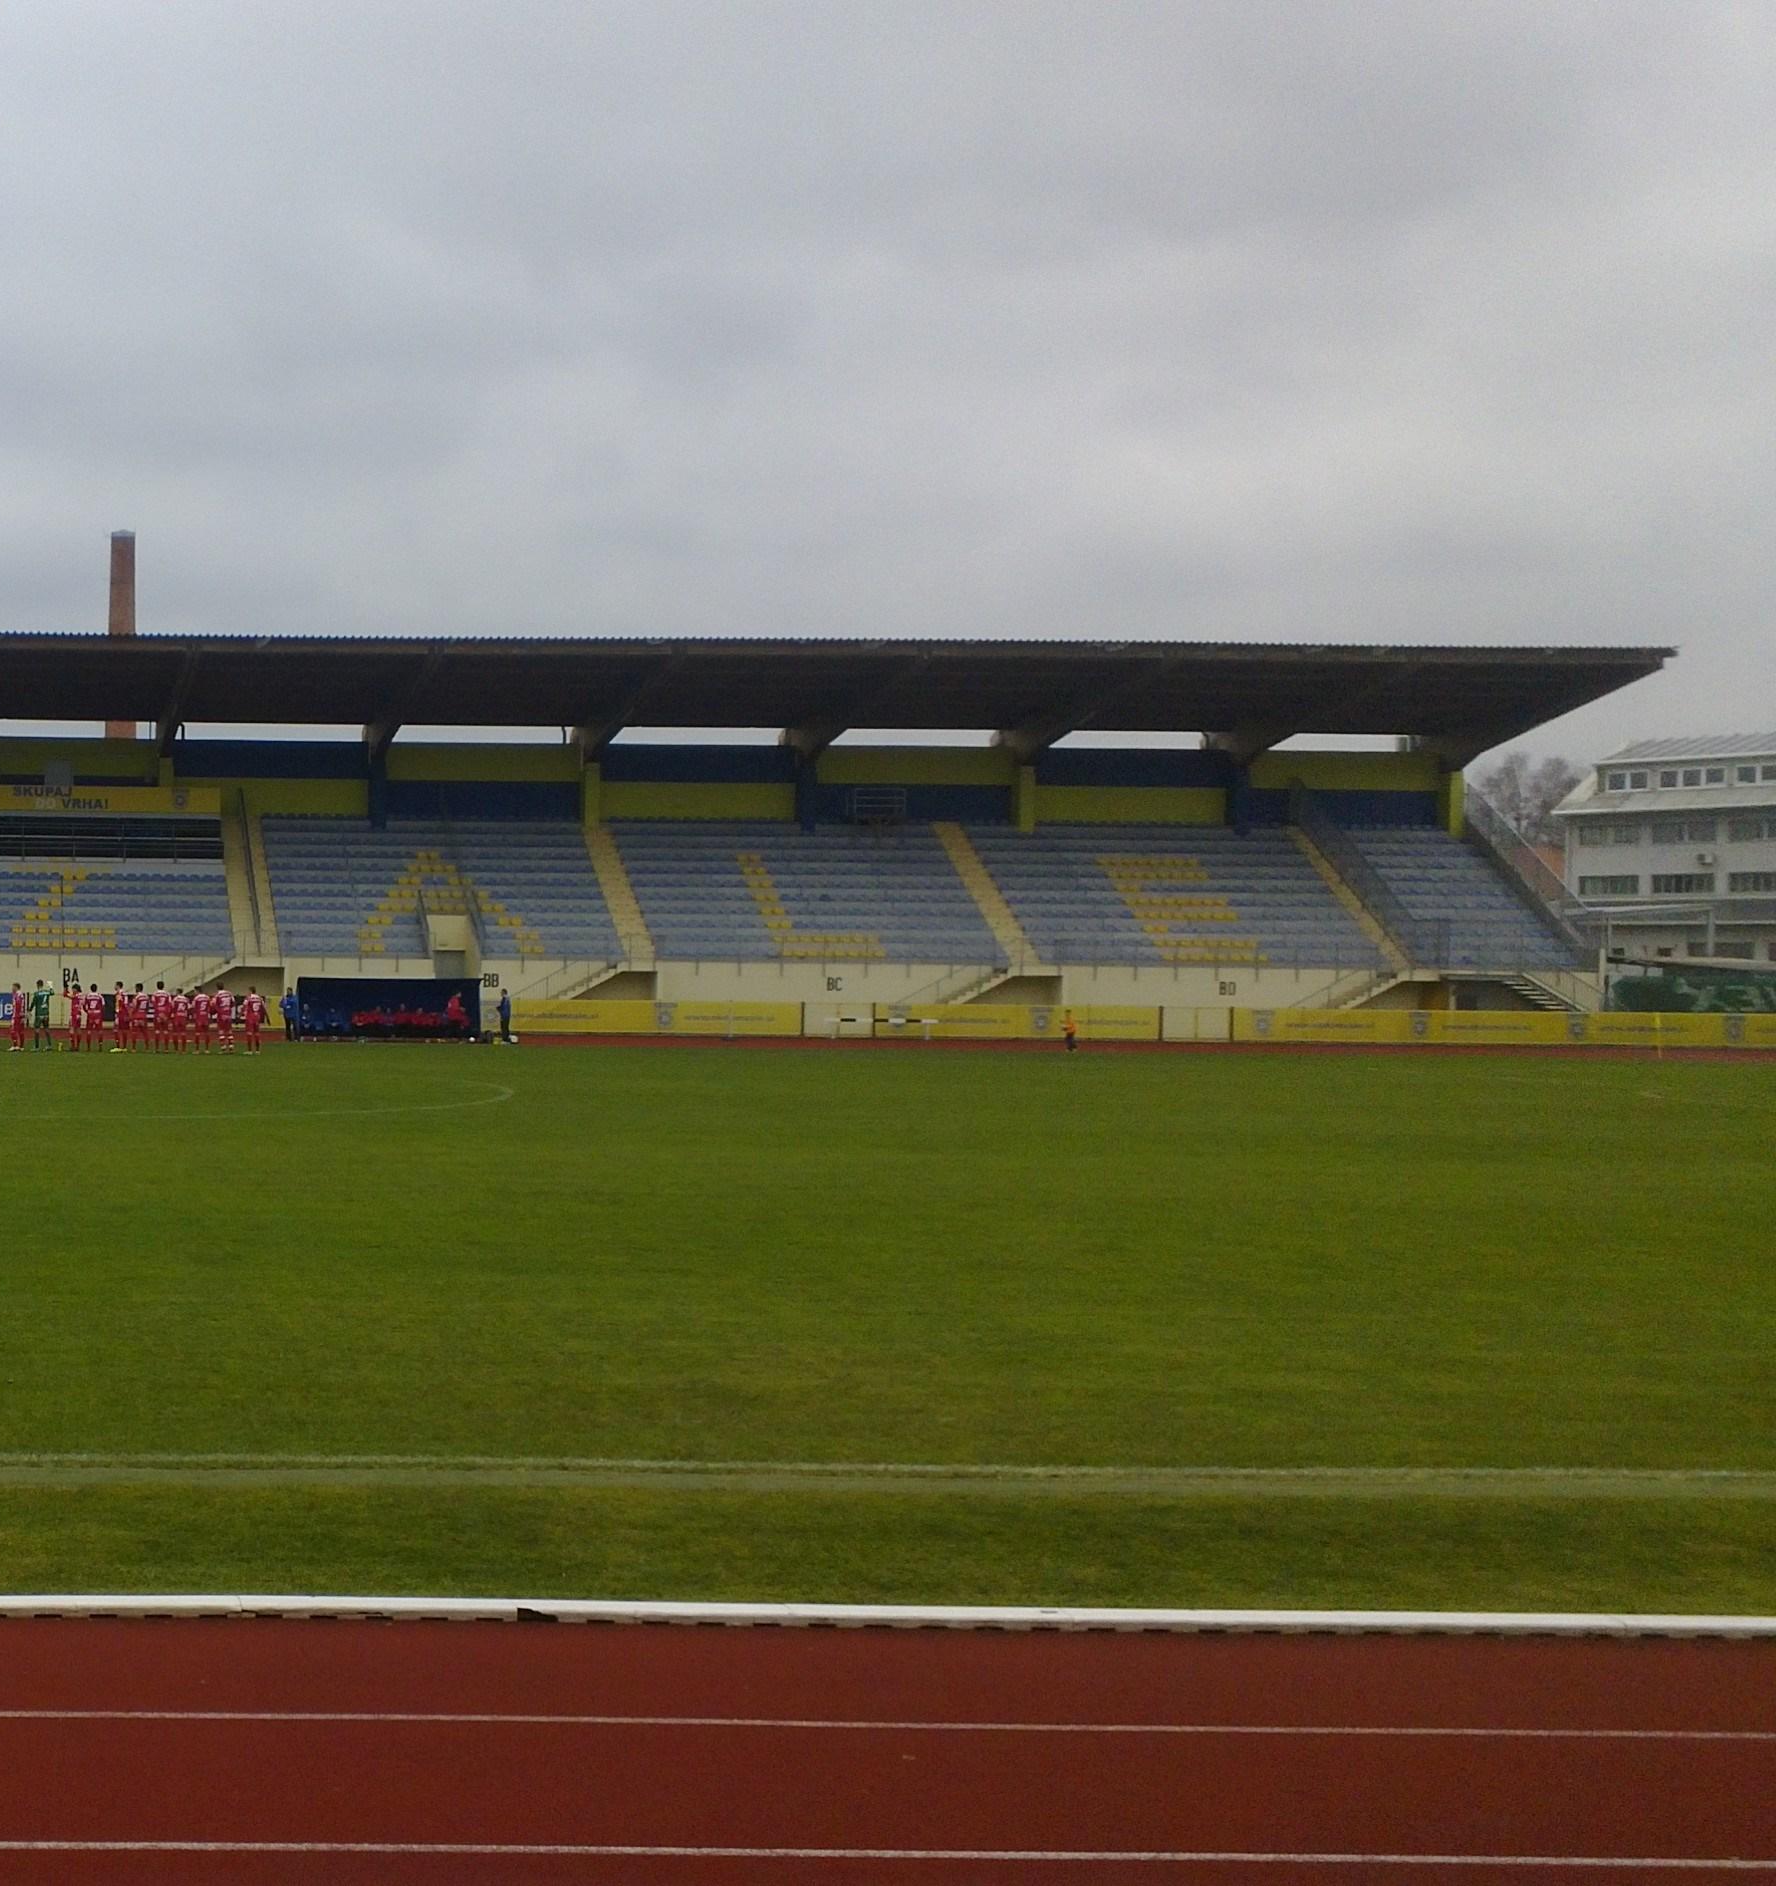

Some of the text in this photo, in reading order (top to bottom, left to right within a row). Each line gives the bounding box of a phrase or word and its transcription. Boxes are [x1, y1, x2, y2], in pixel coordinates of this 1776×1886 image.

[12, 785, 73, 798] SKUPAJ
[62, 967, 80, 988] BA
[482, 972, 500, 988] BB
[826, 977, 843, 992] BC
